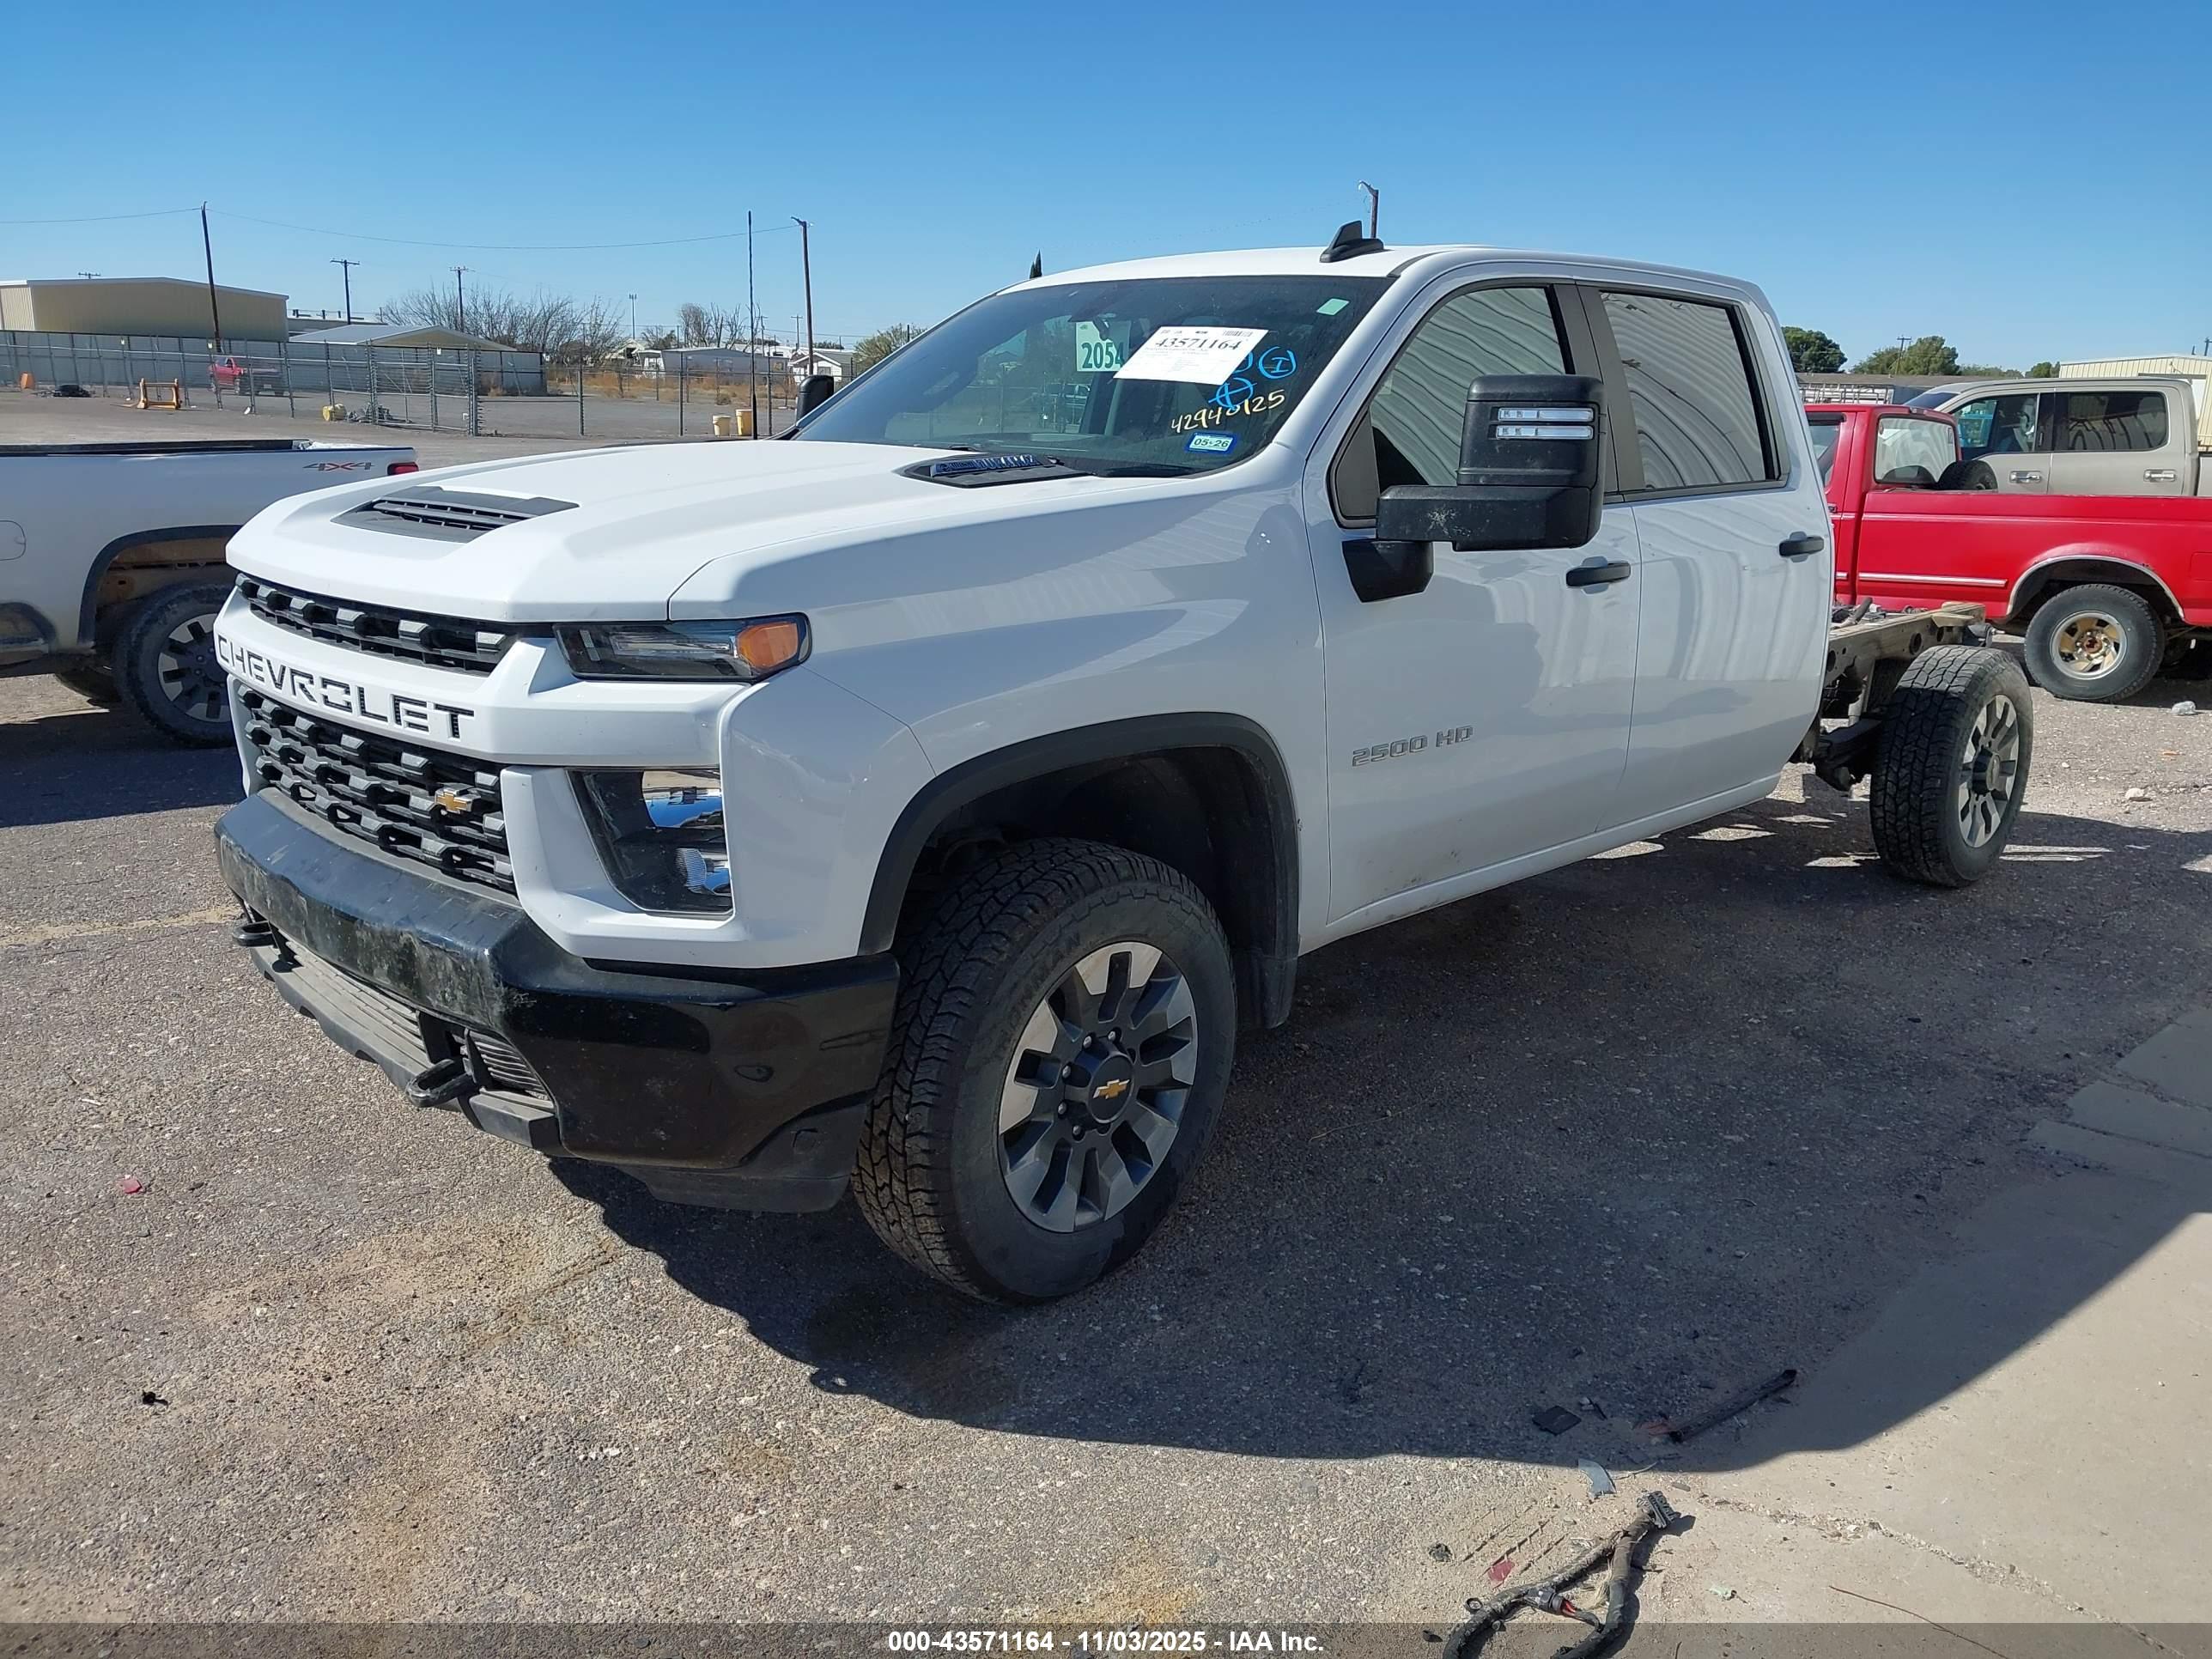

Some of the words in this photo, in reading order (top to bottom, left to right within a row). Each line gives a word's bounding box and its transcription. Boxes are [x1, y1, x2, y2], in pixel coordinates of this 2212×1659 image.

[1081, 342, 1125, 368] 2054
[1155, 337, 1243, 349] 43571164
[217, 634, 475, 740] CHEVROLET
[1352, 734, 1428, 767] 2500
[1435, 725, 1474, 747] HD
